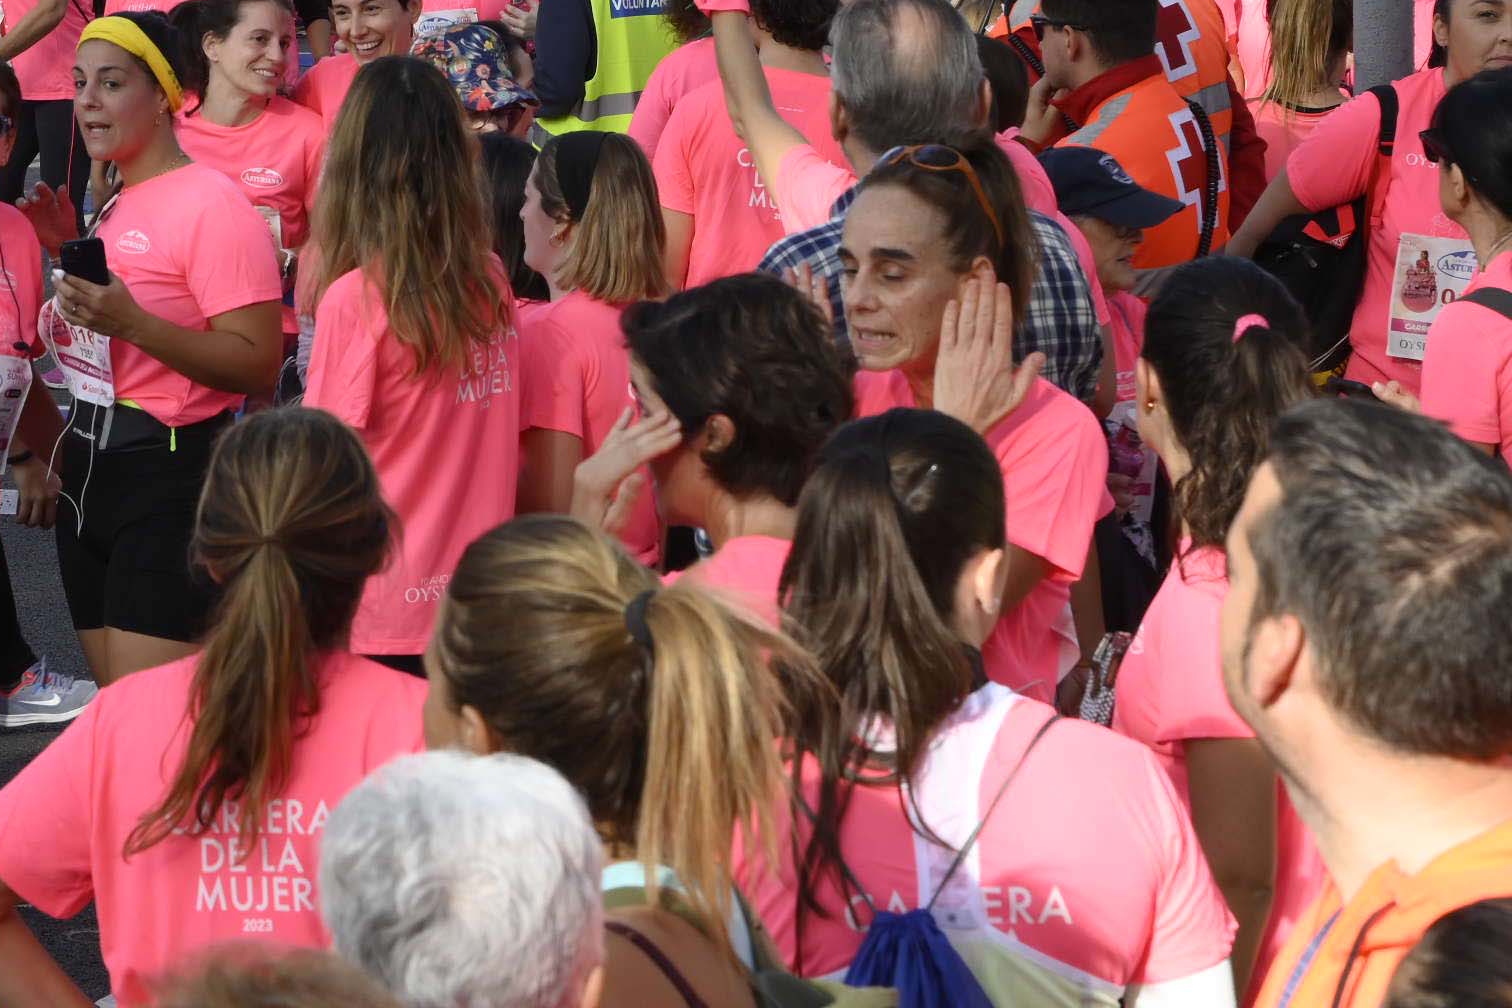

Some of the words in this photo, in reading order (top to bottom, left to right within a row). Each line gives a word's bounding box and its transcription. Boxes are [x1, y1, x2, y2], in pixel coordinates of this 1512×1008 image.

[1406, 152, 1440, 169] OYS
[261, 837, 305, 874] LA
[195, 875, 315, 913] MUJER
[242, 917, 274, 933] 2023
